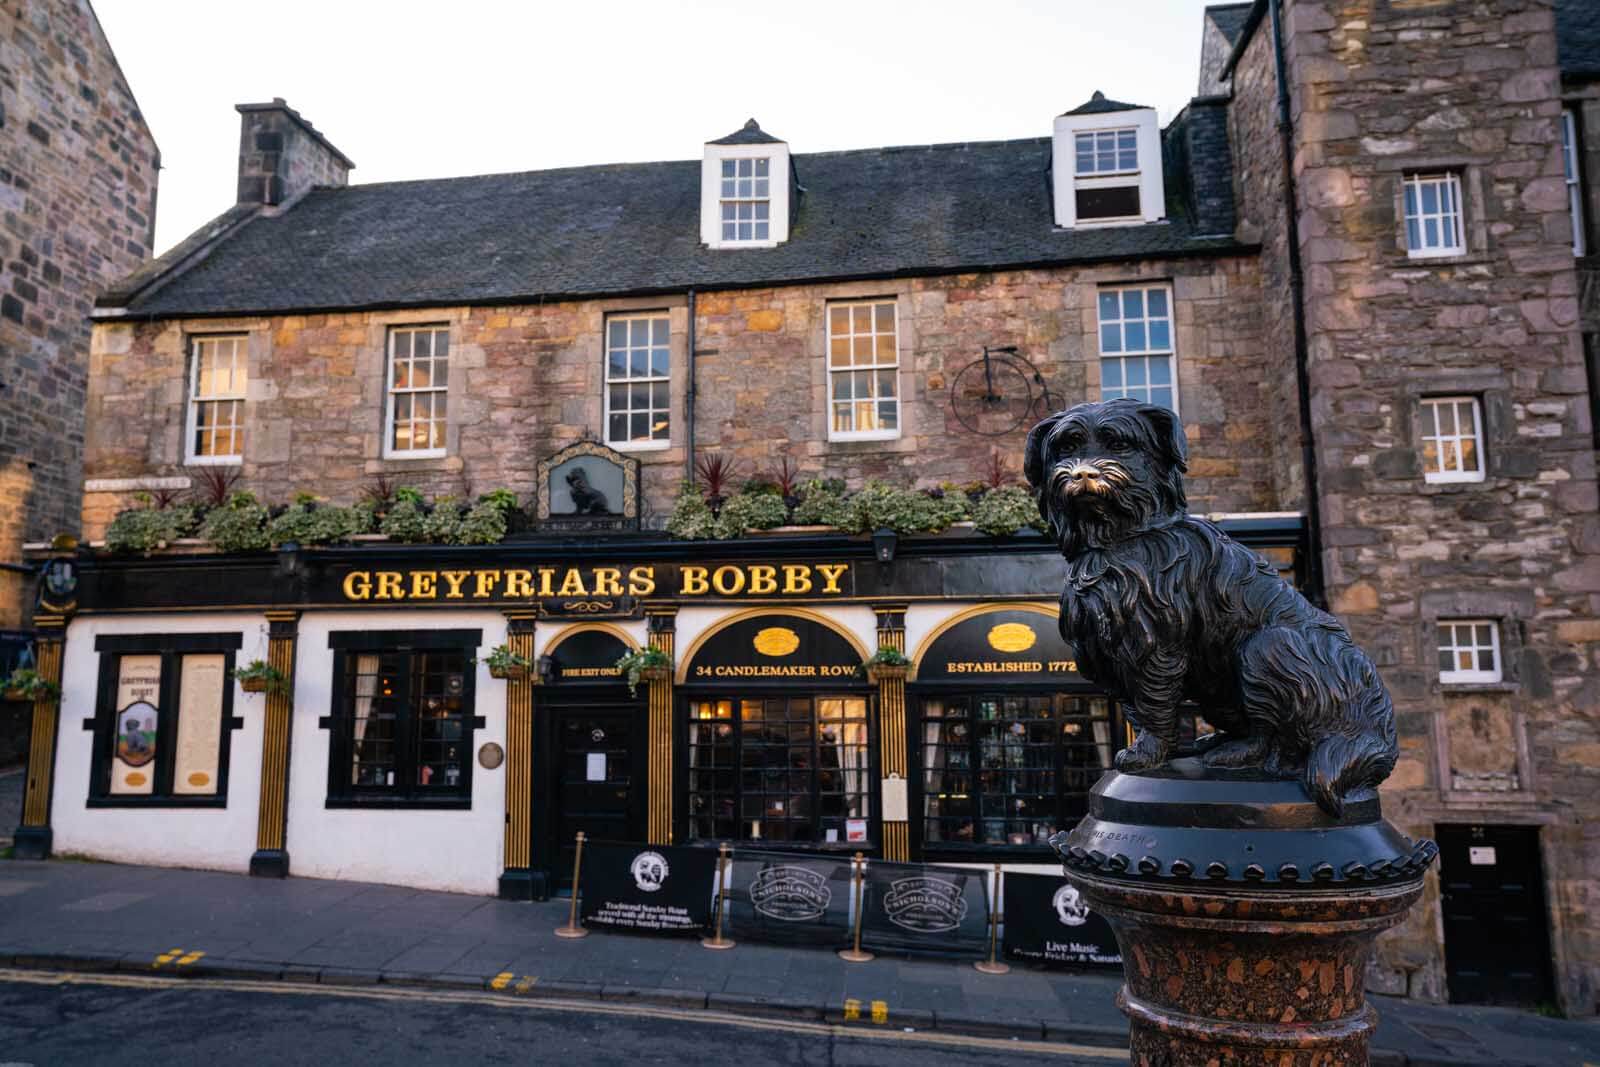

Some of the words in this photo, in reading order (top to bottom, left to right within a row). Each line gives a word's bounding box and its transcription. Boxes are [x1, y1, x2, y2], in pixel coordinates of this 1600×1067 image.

[343, 567, 656, 600] GREYFRIARS
[680, 564, 849, 596] BOBBY
[600, 667, 622, 676] ONLY
[696, 665, 713, 676] 34
[715, 665, 816, 676] CANDLEMAKER
[820, 665, 857, 676] ROW
[947, 661, 1042, 672] ESTABLISHED
[1048, 660, 1077, 672] 1772
[1107, 832, 1145, 843] DEATH
[605, 902, 641, 911] Traditional
[642, 904, 666, 914] Sunday
[636, 920, 660, 929] Sunday
[1046, 941, 1067, 952] Live
[1069, 942, 1099, 953] Music
